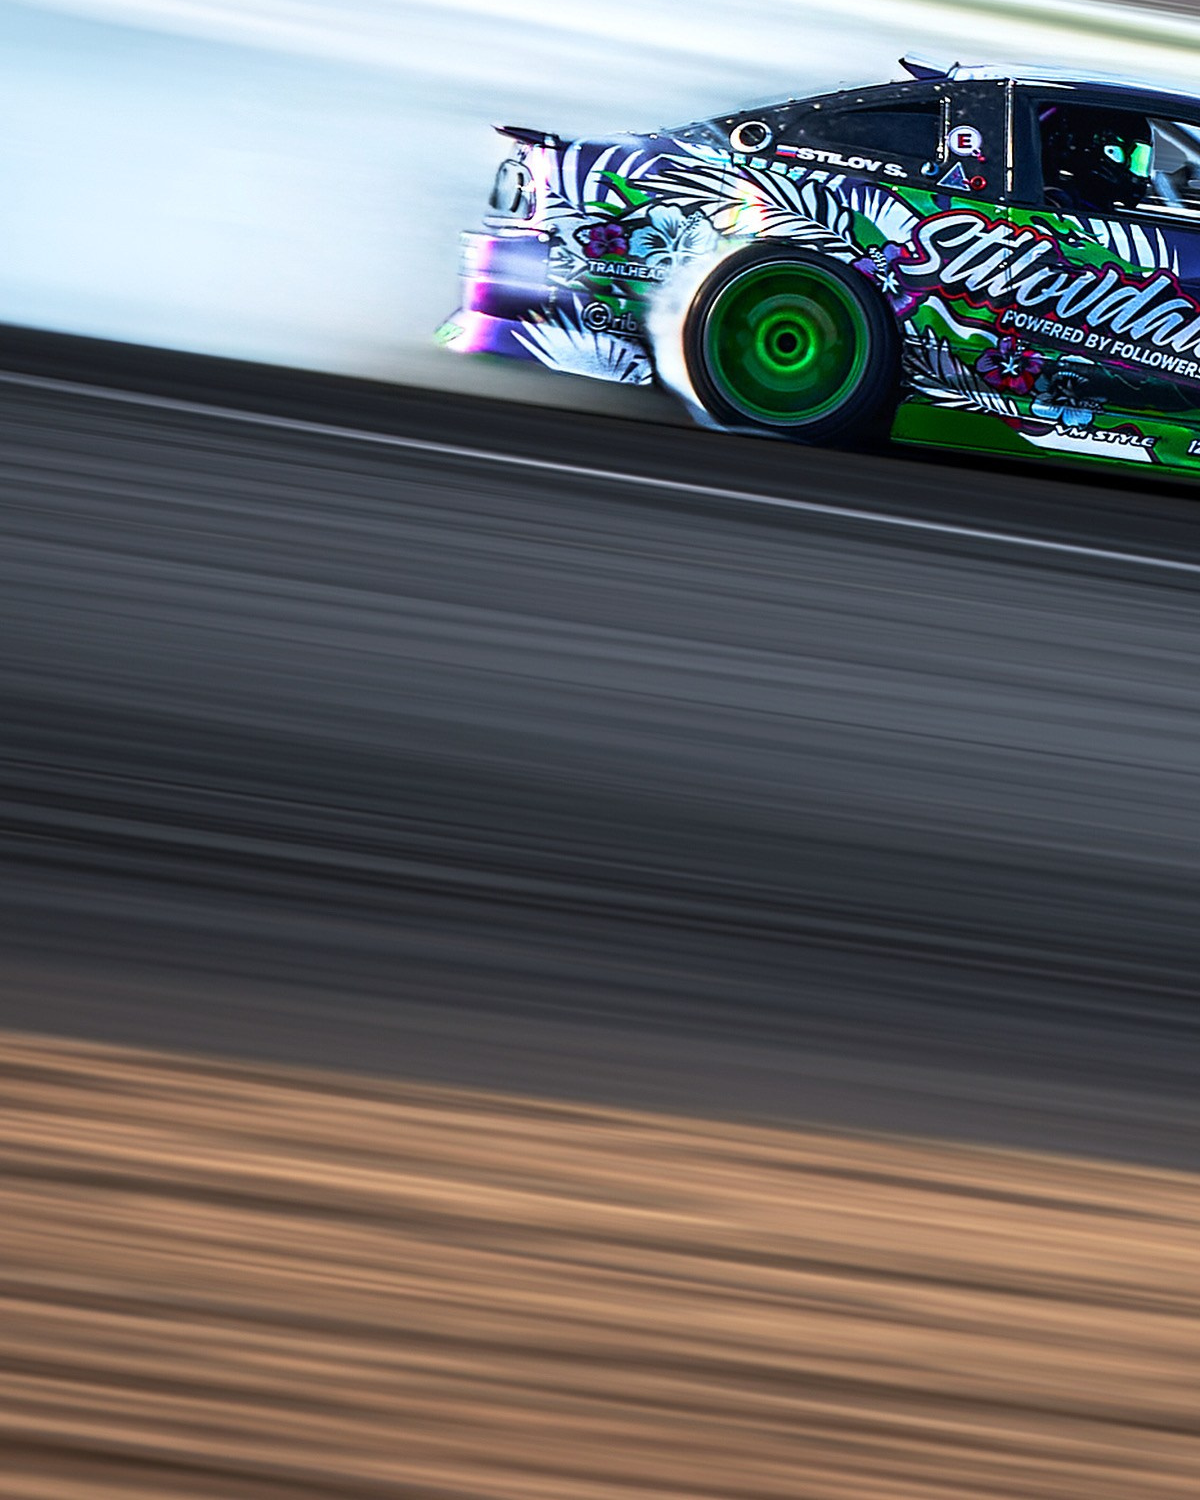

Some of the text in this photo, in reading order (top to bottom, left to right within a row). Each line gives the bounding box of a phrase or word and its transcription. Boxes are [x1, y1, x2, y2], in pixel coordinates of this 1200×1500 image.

[796, 147, 908, 178] STILOV S.
[1001, 310, 1084, 344] POWERED
[1085, 333, 1111, 350] BY
[1093, 431, 1155, 447] STYLE
